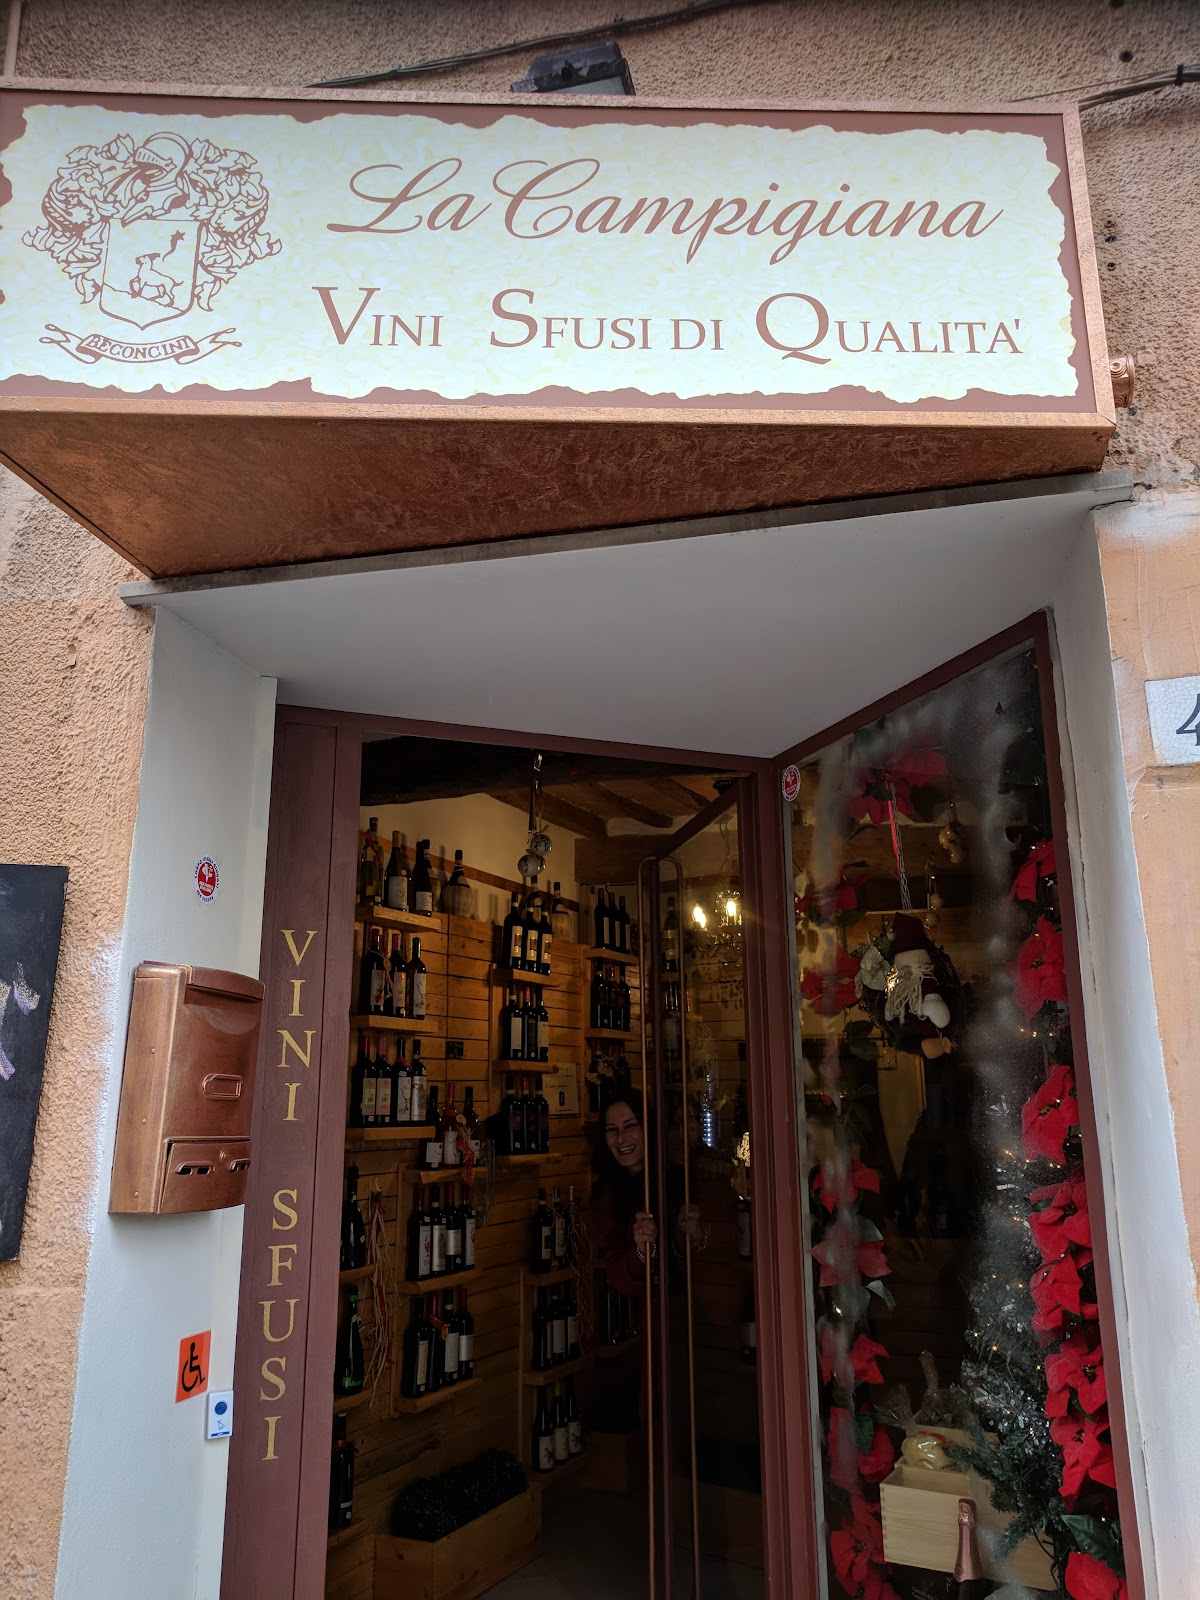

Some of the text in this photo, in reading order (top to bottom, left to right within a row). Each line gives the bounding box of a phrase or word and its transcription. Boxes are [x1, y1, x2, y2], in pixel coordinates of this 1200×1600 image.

[326, 157, 1003, 265] La Campigiana
[86, 335, 190, 360] BECONCINI
[669, 319, 724, 351] DI
[260, 930, 316, 1461] VINI SFUSI
